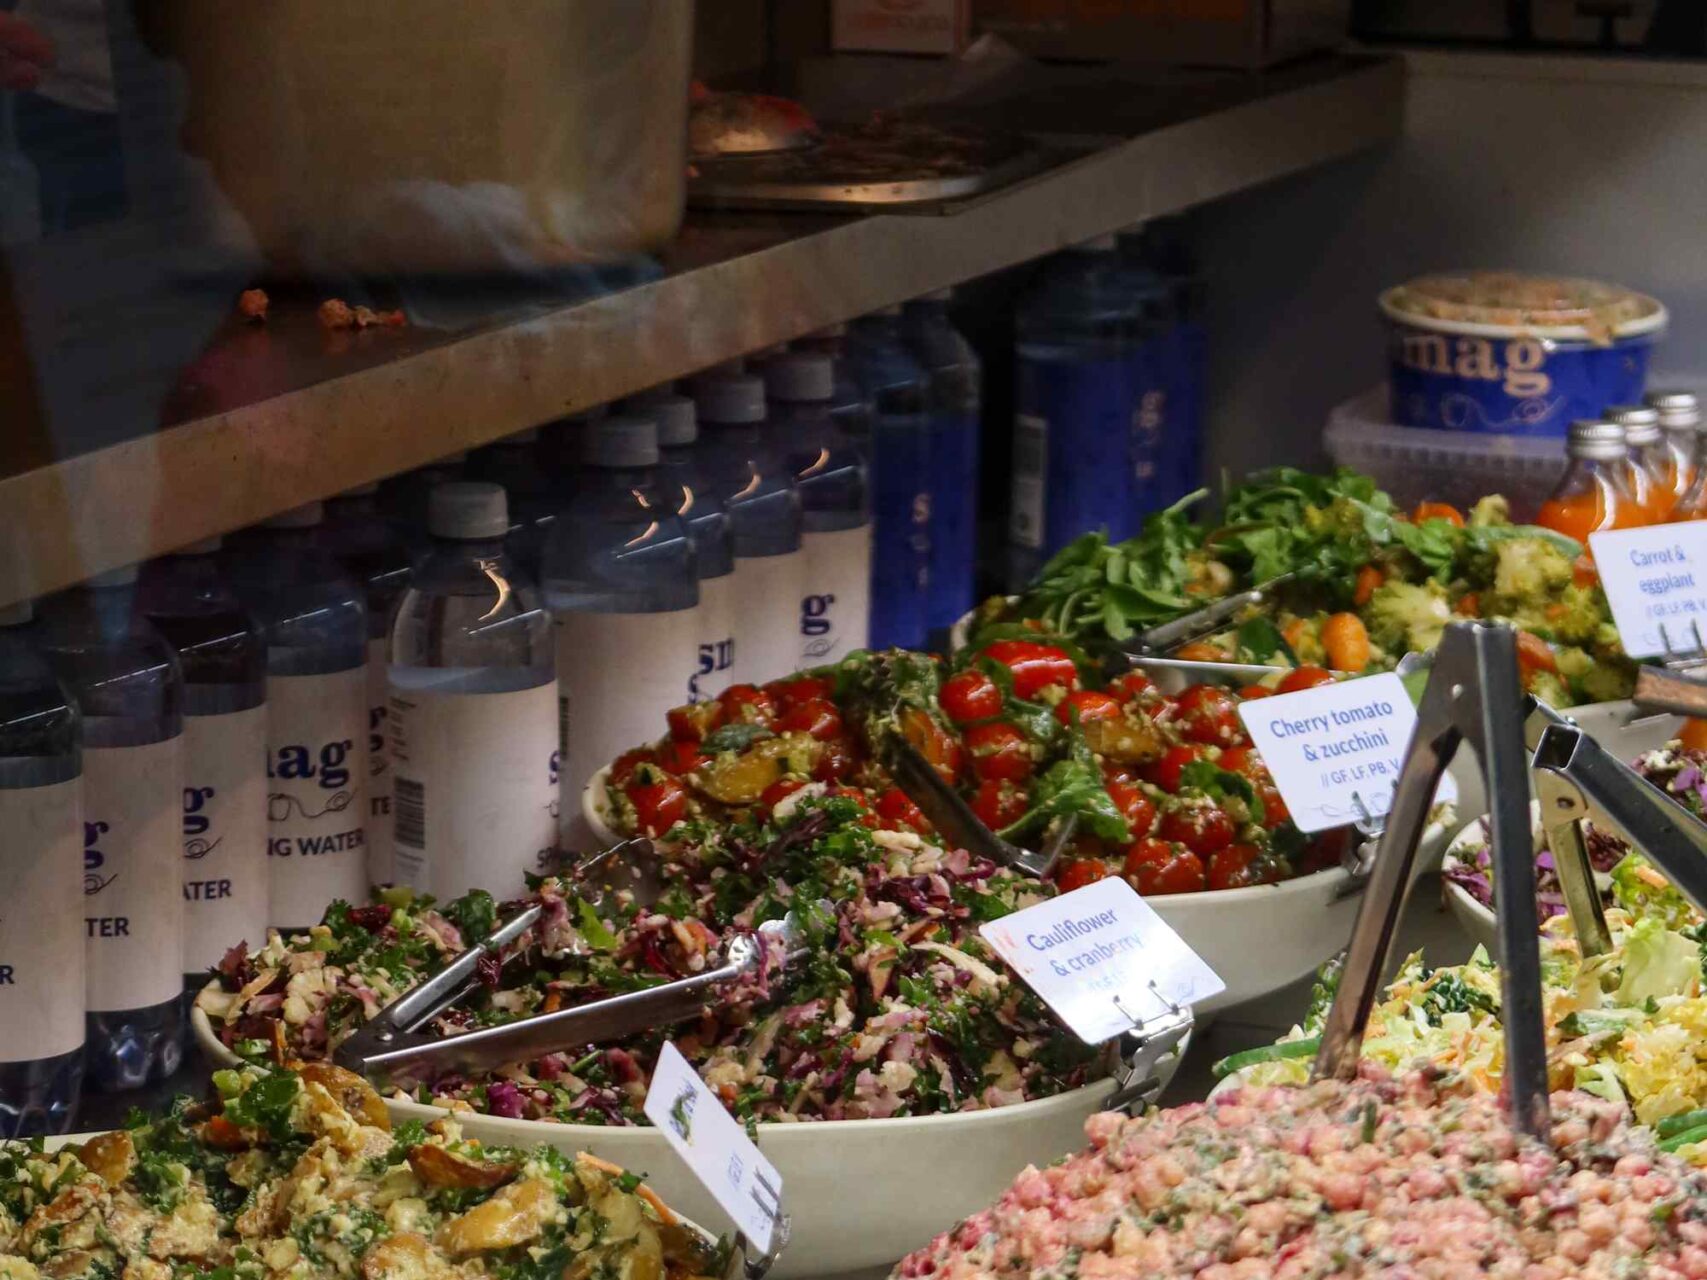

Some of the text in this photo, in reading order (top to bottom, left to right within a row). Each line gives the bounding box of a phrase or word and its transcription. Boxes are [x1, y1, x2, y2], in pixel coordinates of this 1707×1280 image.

[1630, 544, 1686, 566] Carrot &
[1639, 572, 1695, 595] eggplant
[1270, 700, 1393, 739] Cherry tomato
[1303, 727, 1390, 762] & zucchini
[267, 740, 353, 789] ag
[297, 828, 364, 856] WATER
[1026, 908, 1119, 952] Cauliflower
[1050, 932, 1144, 977] & cranberry
